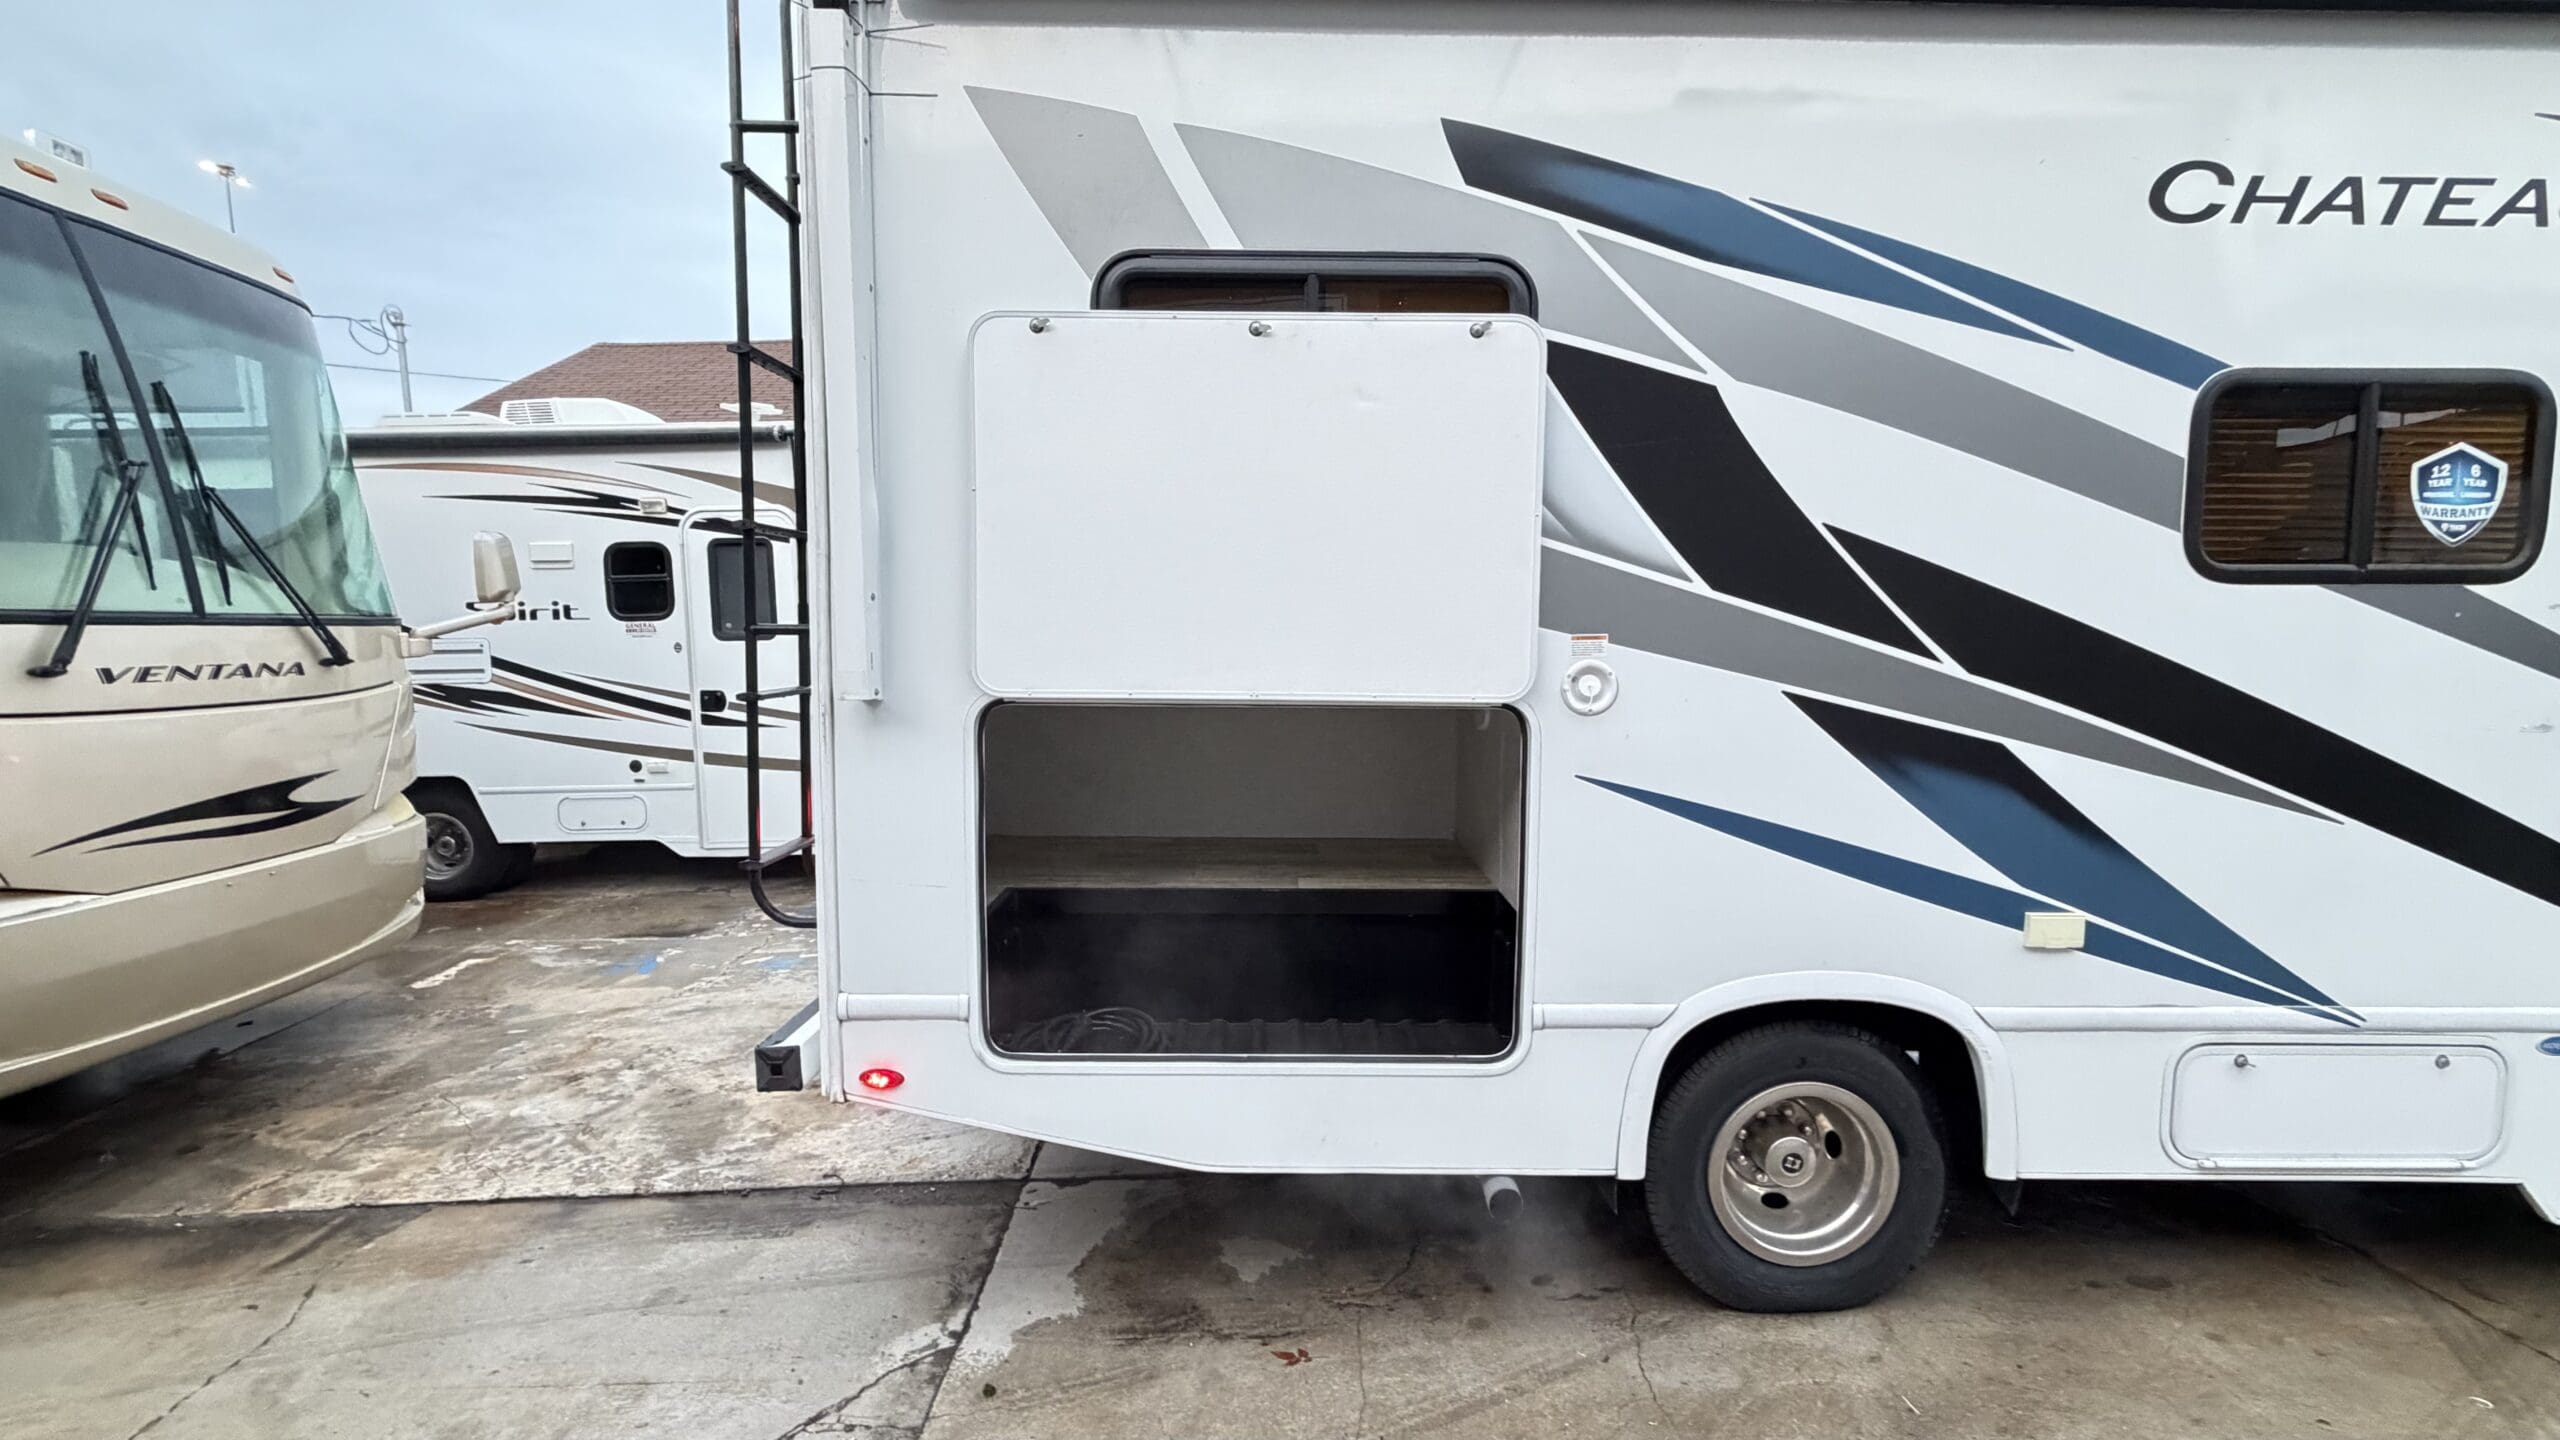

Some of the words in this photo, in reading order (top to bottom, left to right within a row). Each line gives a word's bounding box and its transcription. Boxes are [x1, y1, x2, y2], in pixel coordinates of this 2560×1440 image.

[2148, 159, 2560, 228] CHATEA
[2431, 463, 2451, 478] 12
[2470, 464, 2481, 477] 6
[2428, 478, 2453, 487] YEAR
[2463, 478, 2488, 487] YEAR
[2421, 506, 2493, 518] WARRANTY
[465, 601, 590, 621] irit
[95, 662, 305, 685] VENTANA
